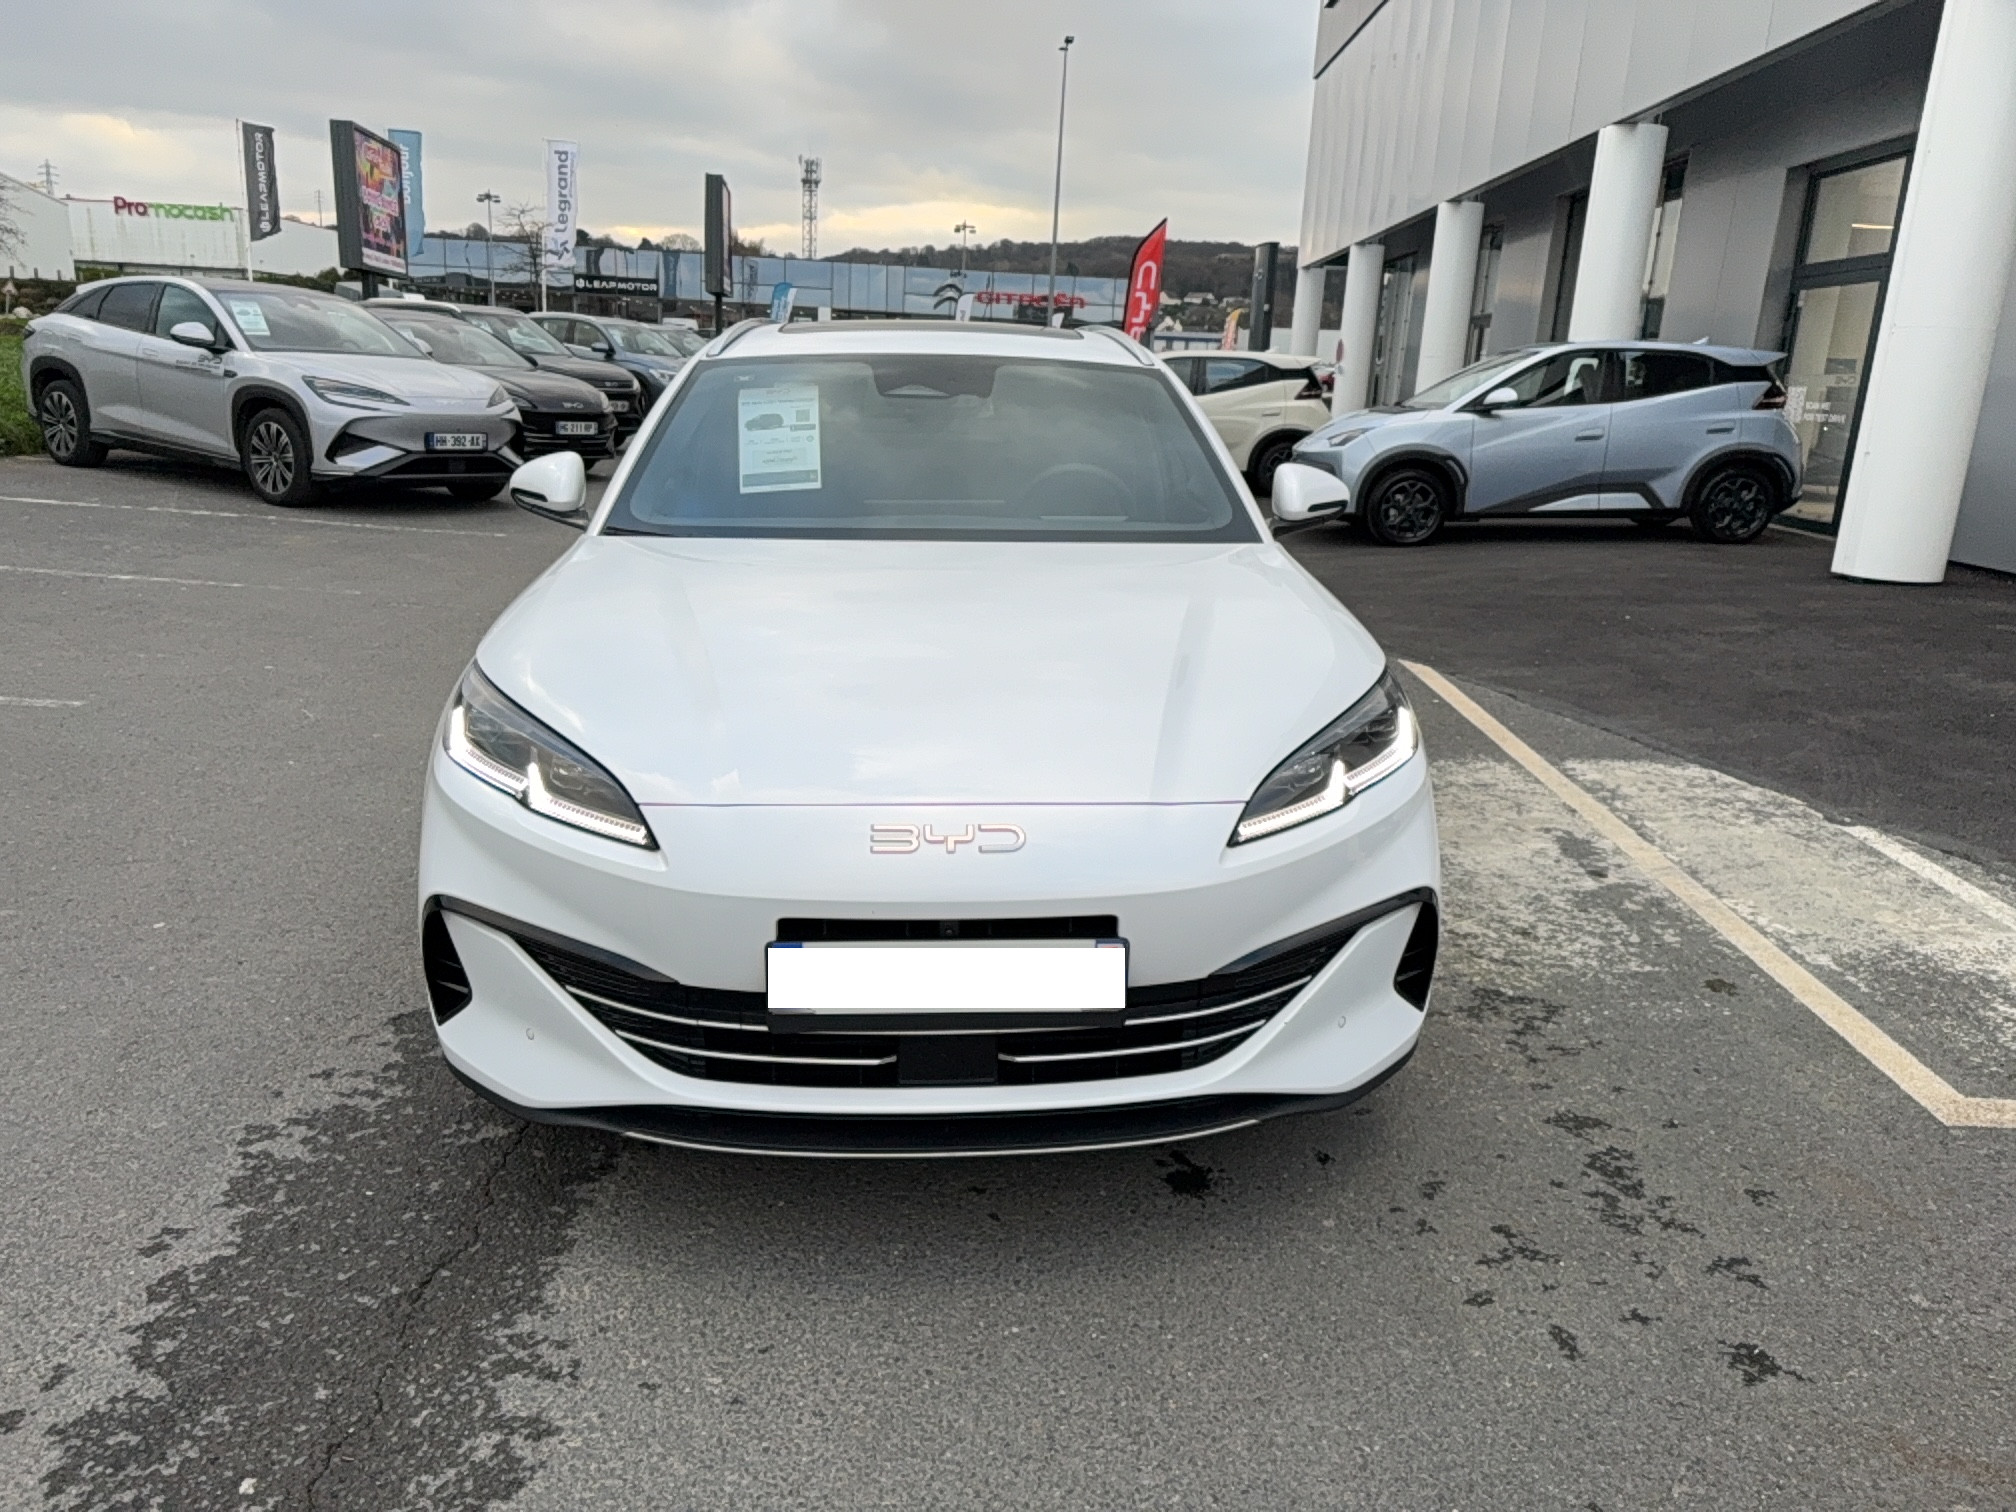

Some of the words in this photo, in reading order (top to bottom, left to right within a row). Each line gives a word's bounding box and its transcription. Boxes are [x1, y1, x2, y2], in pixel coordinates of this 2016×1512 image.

[554, 149, 572, 233] Legrand
[585, 279, 658, 292] LEAPMOTOR
[870, 823, 1027, 854] BYD
